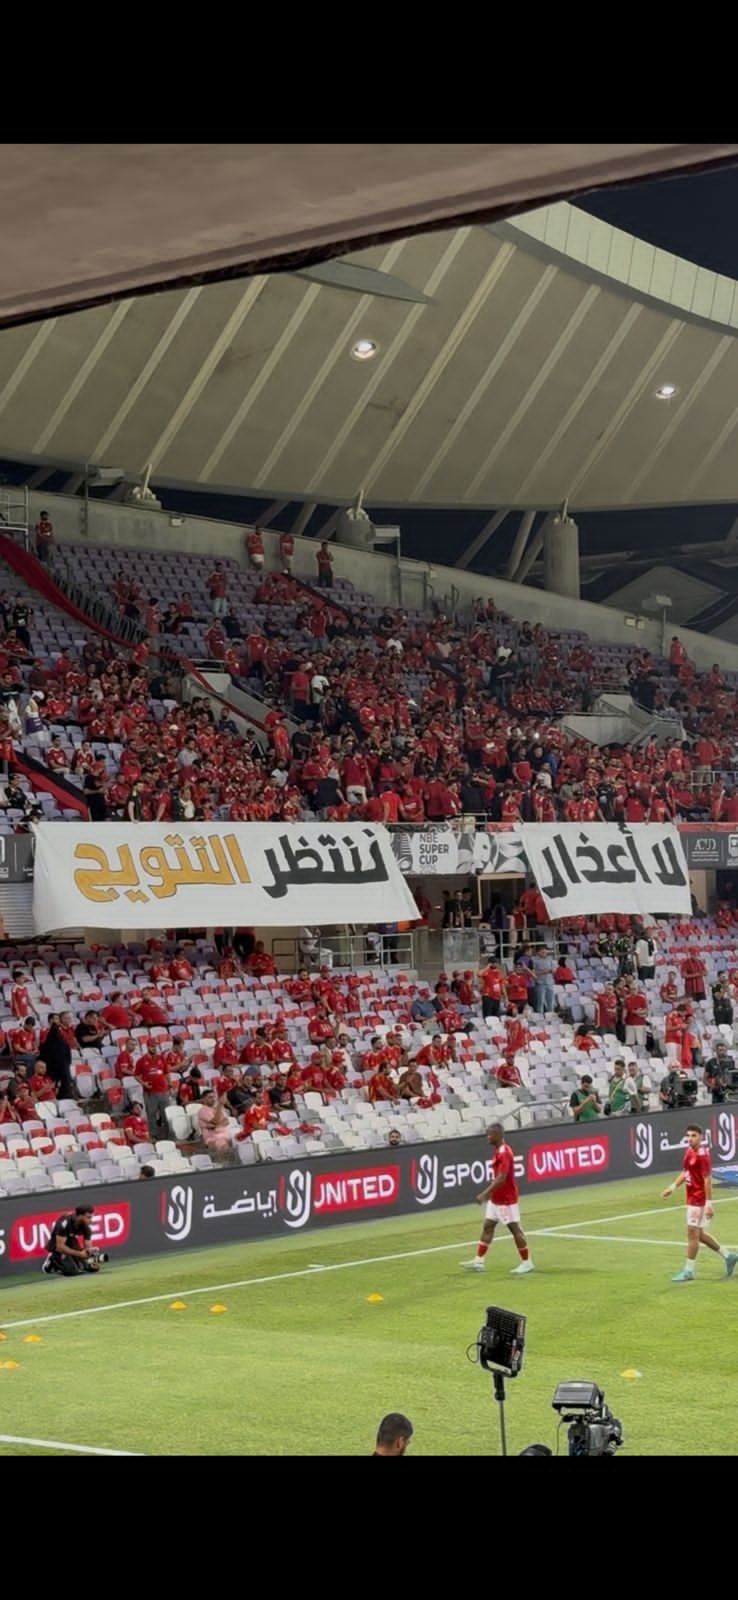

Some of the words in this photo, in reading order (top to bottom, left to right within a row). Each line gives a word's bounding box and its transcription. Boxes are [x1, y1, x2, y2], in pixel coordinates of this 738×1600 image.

[419, 834, 439, 843] NBE
[419, 844, 449, 854] SUPER
[419, 855, 438, 865] CUP
[541, 824, 652, 898] أعذار
[74, 834, 252, 903] التتويج
[262, 828, 389, 899] ننتظر
[655, 837, 687, 886] لا
[442, 1155, 525, 1188] SPORS
[532, 1143, 606, 1175] UNITED
[18, 1212, 125, 1252] UNED
